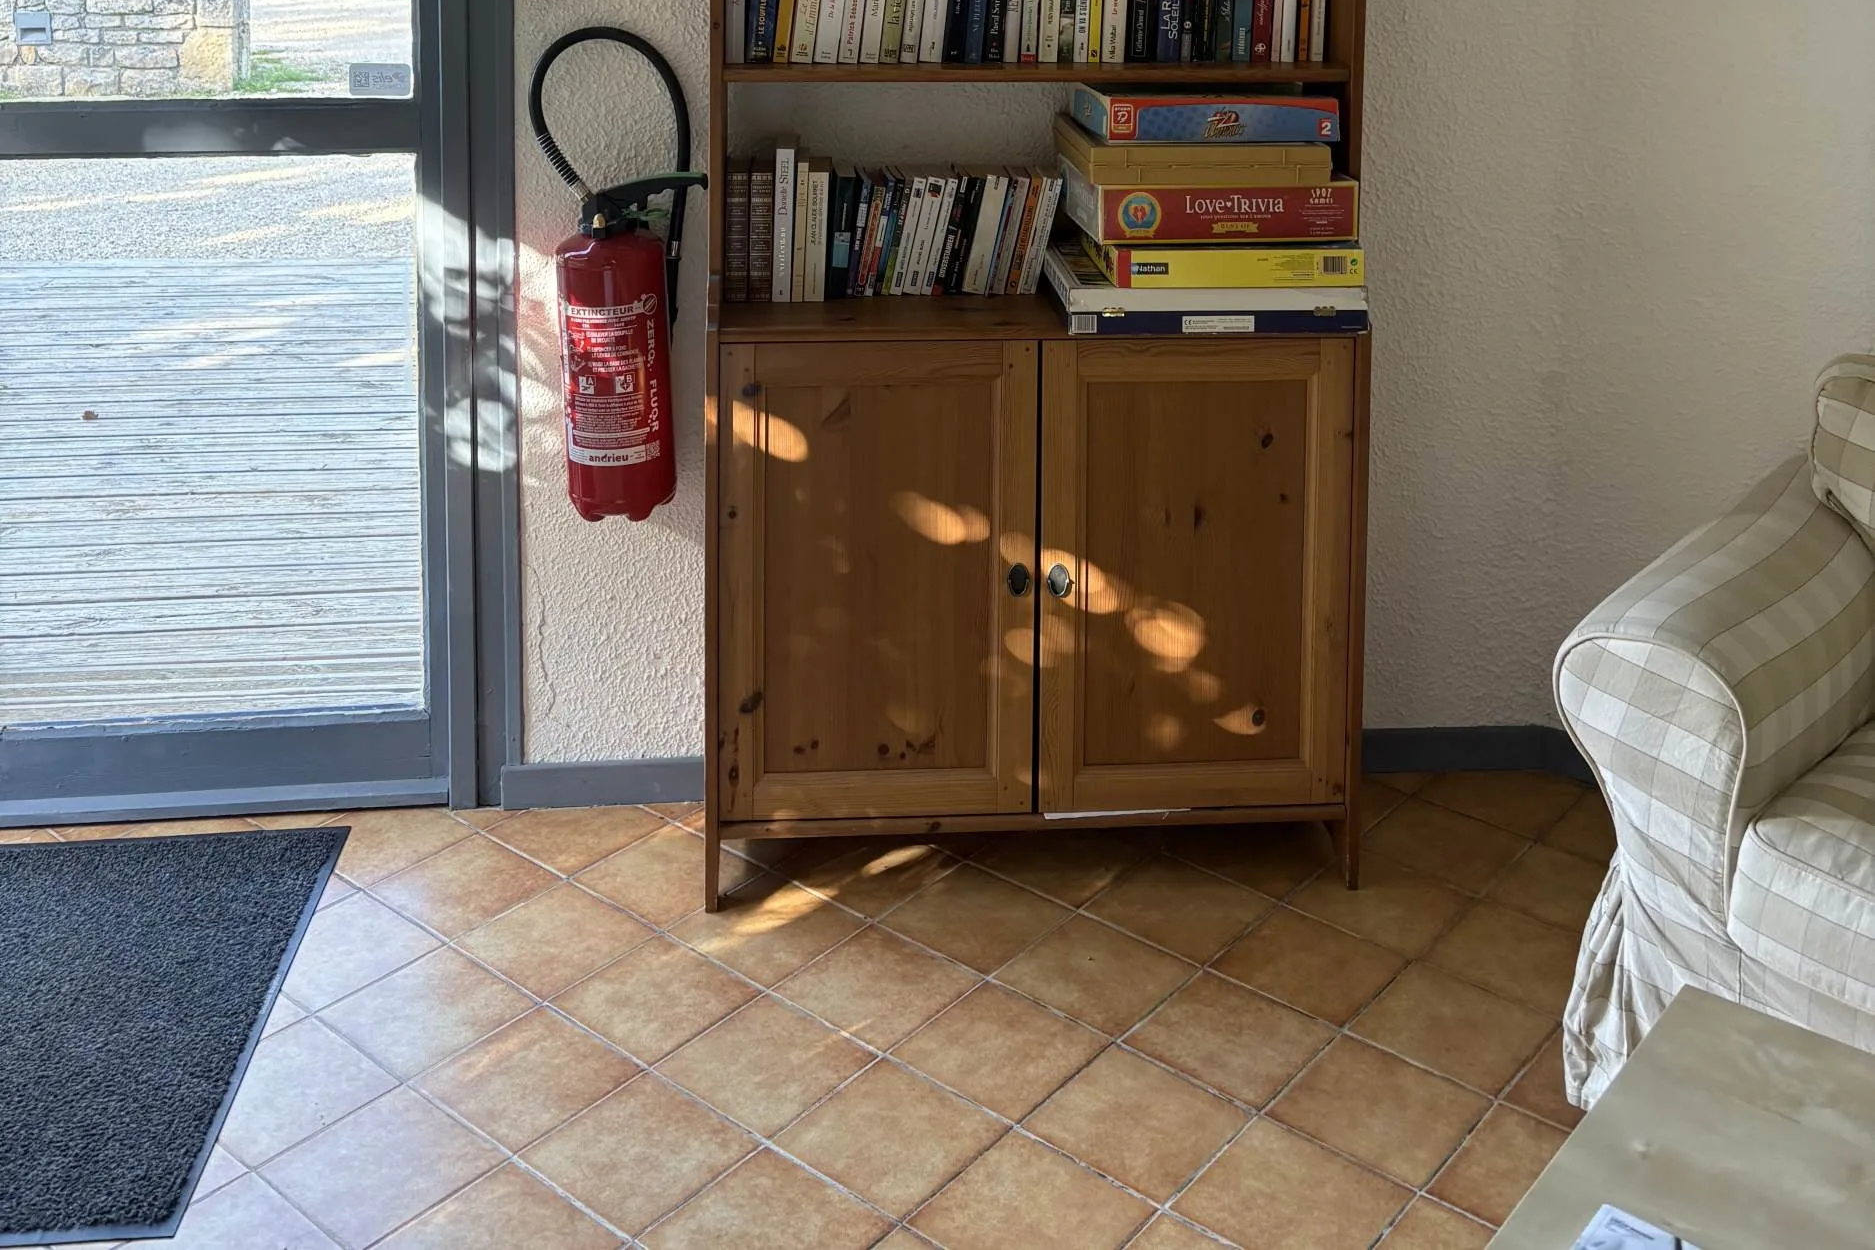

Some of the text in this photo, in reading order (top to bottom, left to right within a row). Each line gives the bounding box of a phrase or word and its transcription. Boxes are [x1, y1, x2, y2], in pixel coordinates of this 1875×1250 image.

[758, 0, 768, 26] SOUFFLE
[1168, 0, 1180, 39] SOLEIL
[887, 15, 901, 26] la
[989, 15, 1000, 35] Pascal
[1078, 17, 1087, 25] VA
[1160, 13, 1171, 30] LA
[757, 27, 765, 35] LE
[846, 21, 856, 45] Patrick
[1078, 25, 1087, 34] ON
[1108, 45, 1116, 59] Mika
[1320, 122, 1331, 135] 2
[779, 157, 790, 185] STEEL
[810, 206, 818, 230] CLAUDE
[1136, 264, 1166, 273] Nathan
[571, 305, 634, 317] EXTINCTEUR
[646, 318, 656, 362] ZERO
[587, 376, 594, 385] A
[626, 374, 633, 383] B
[649, 379, 660, 433] FLUOR
[589, 454, 629, 463] andrieu
